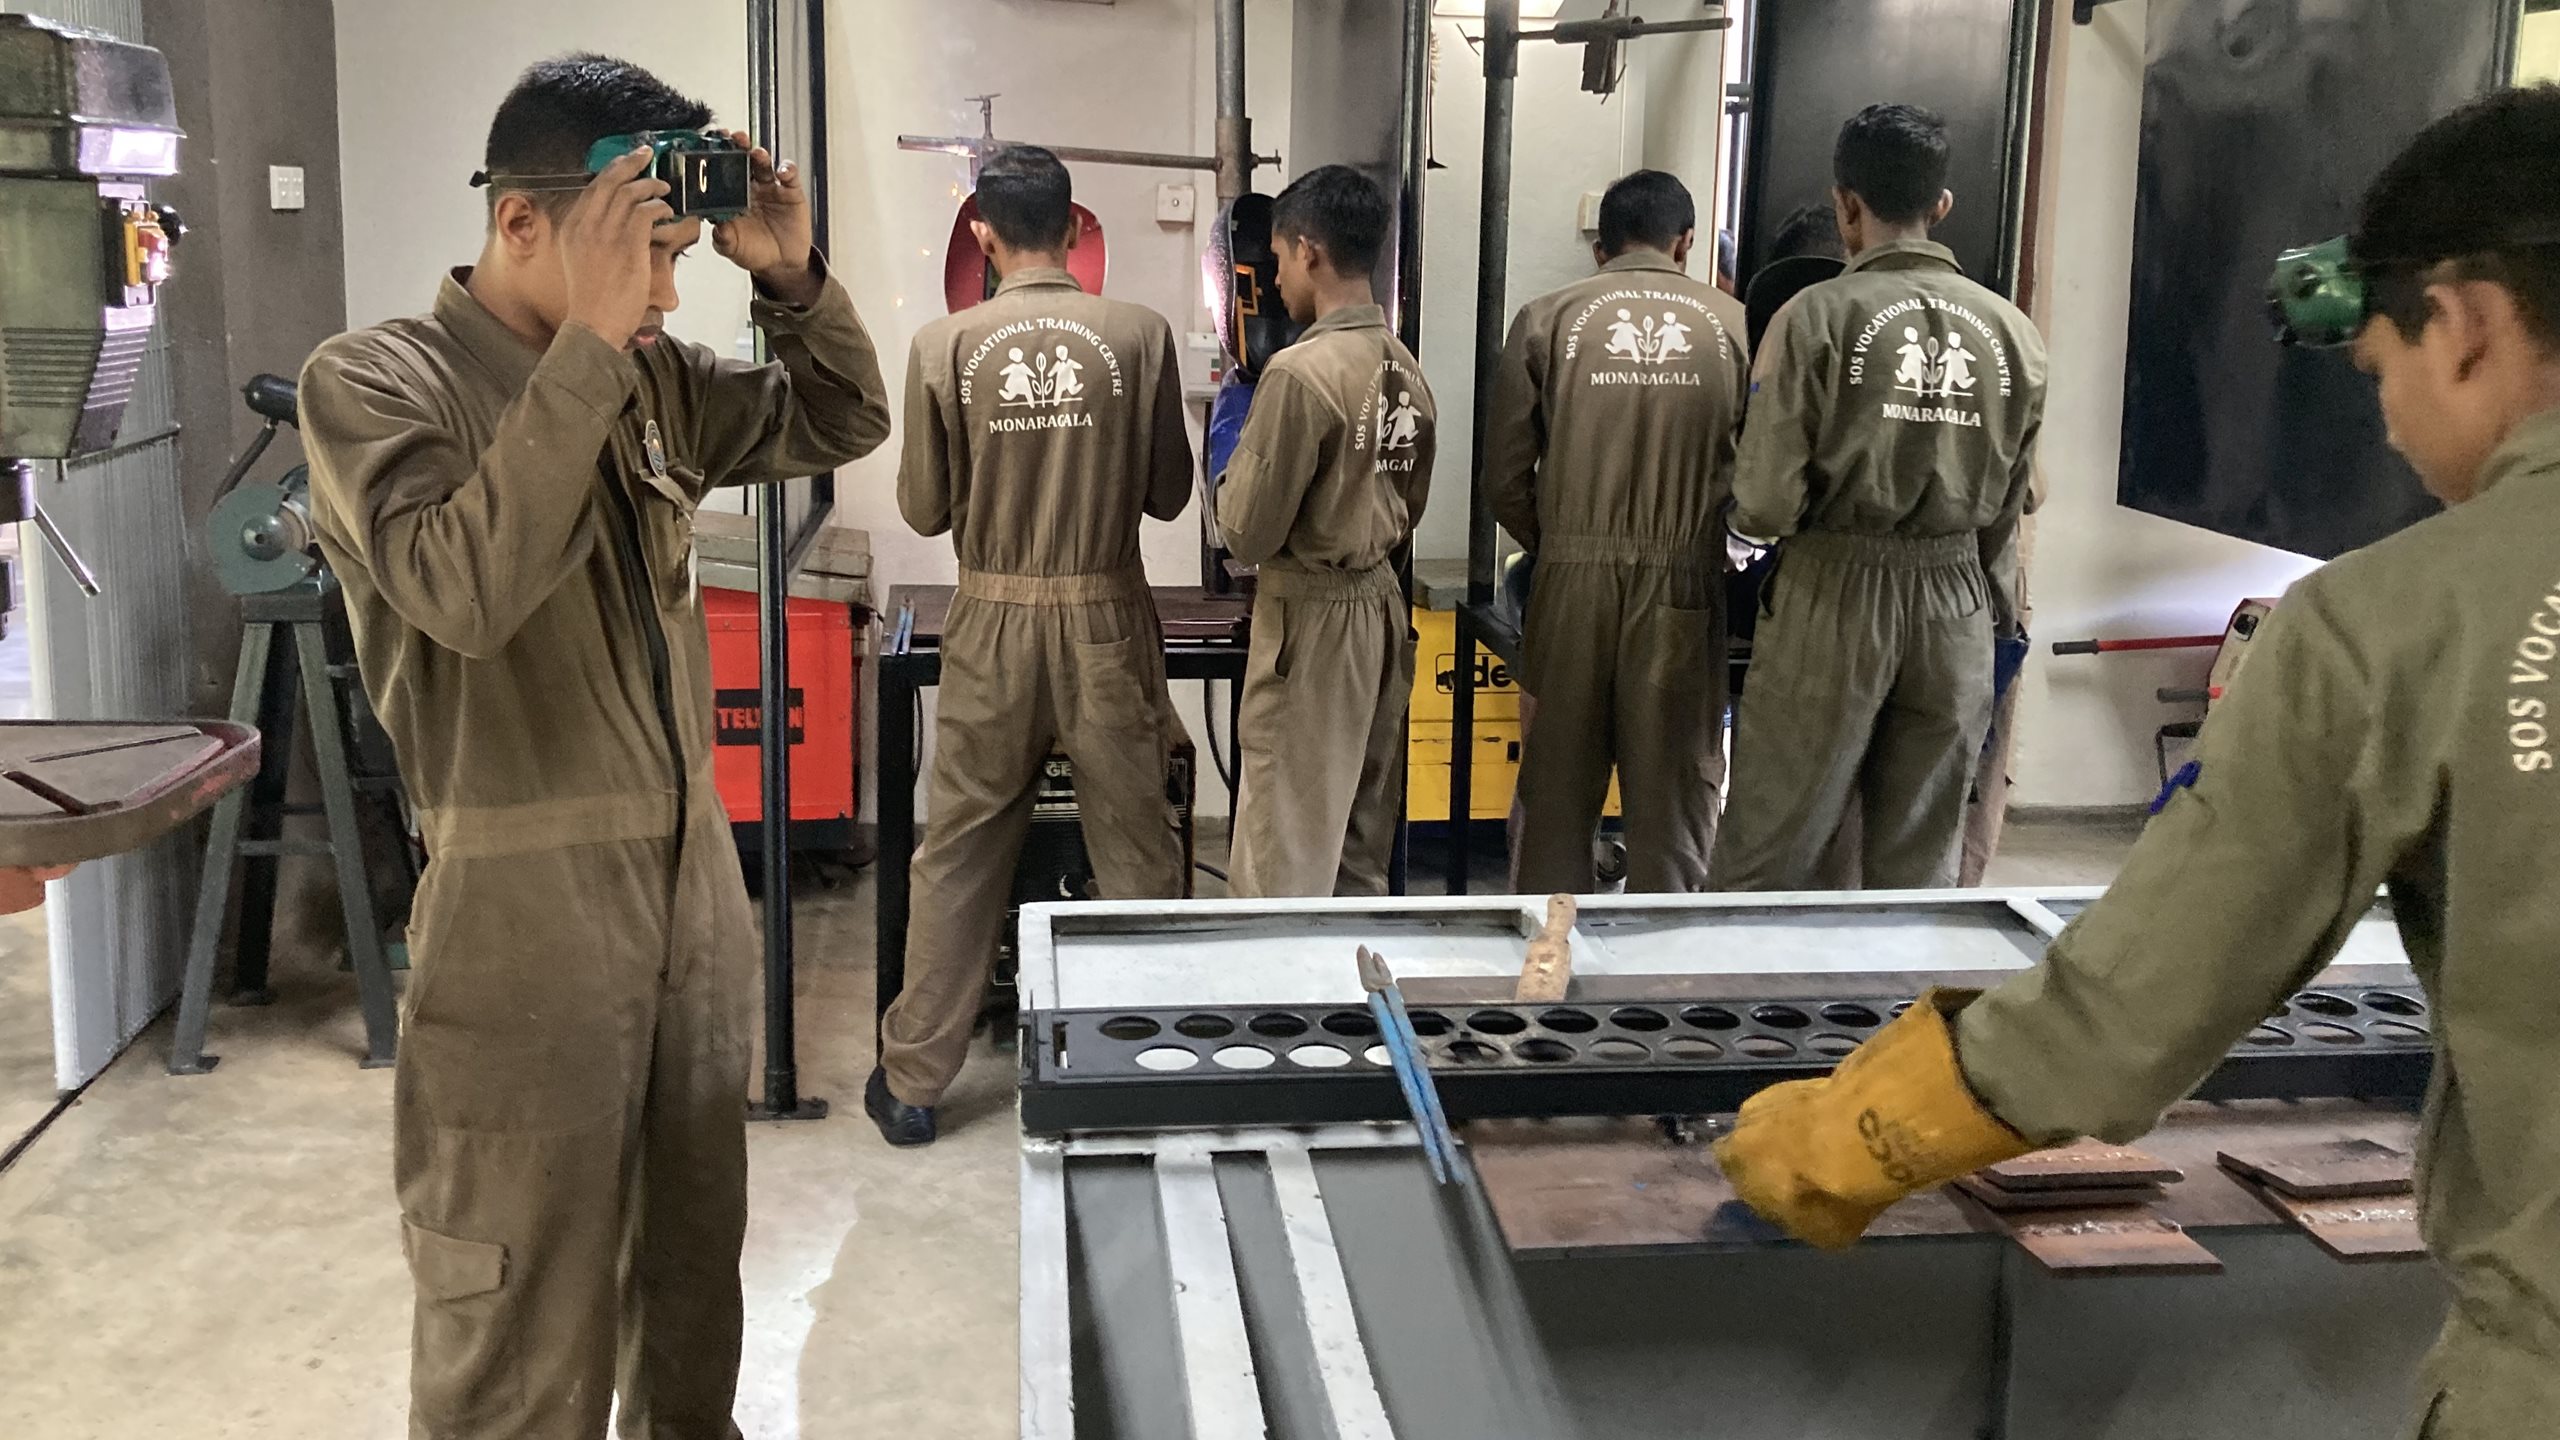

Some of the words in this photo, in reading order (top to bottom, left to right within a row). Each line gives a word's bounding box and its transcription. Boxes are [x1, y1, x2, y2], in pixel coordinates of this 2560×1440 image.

[1571, 290, 1642, 333] VOCATIONAL
[1643, 290, 1707, 313] TRAINING
[1036, 318, 1100, 347] TRAINING
[1854, 298, 1925, 353] VOCATIONAL
[1927, 298, 1993, 338] TRAINING
[964, 320, 1034, 377] VOCATIONAL
[1566, 335, 1578, 359] SOS
[1099, 343, 1124, 397] CENTRE
[1590, 371, 1700, 386] MONARAGALA
[1850, 356, 1865, 385] SOS
[1989, 338, 2012, 397] CENTRE
[961, 378, 972, 405] SOS
[989, 413, 1093, 434] MONARAGALA
[1355, 424, 1367, 450] SOS
[2507, 698, 2554, 772] SOS
